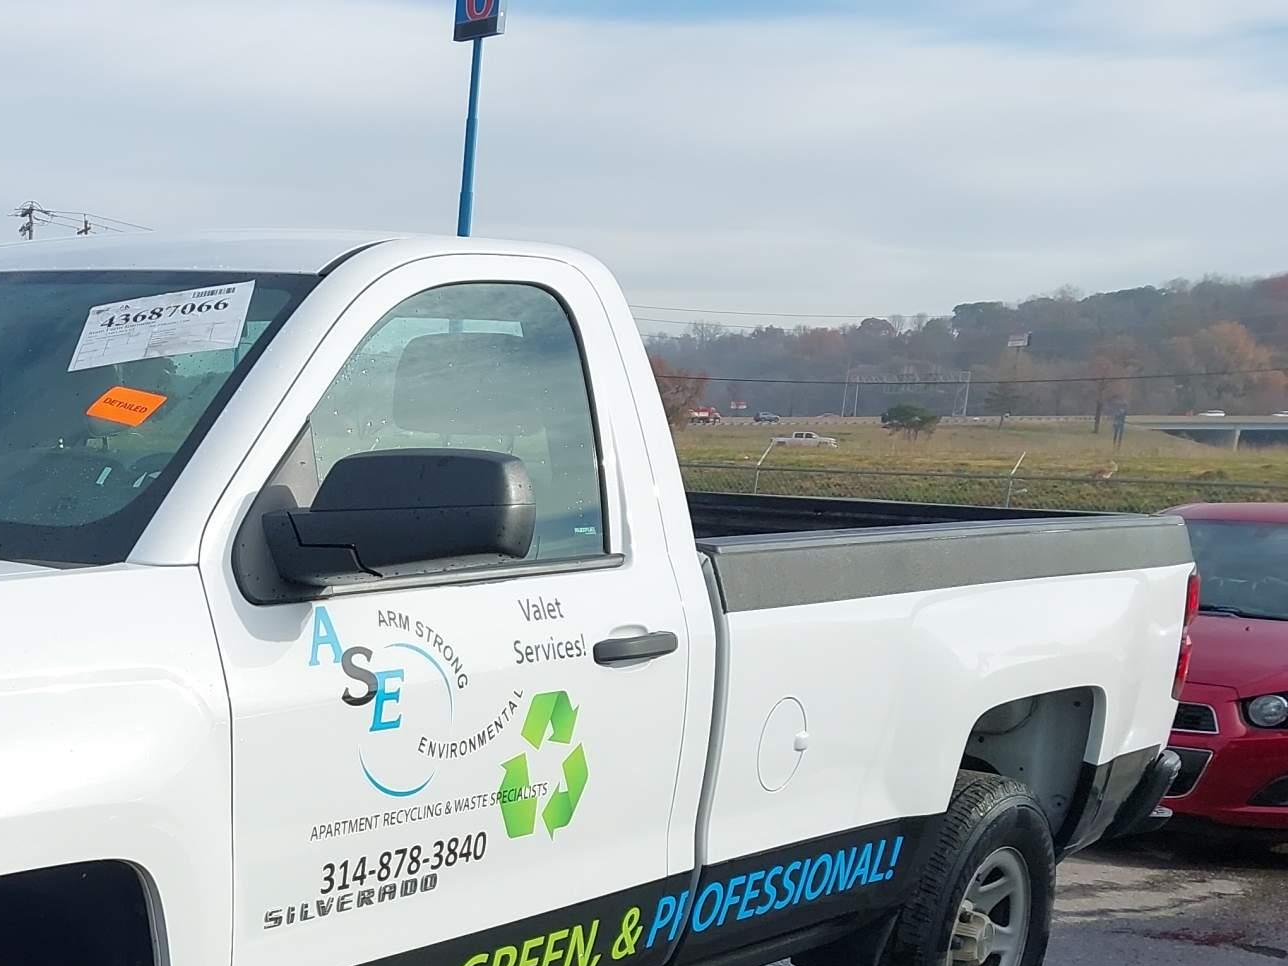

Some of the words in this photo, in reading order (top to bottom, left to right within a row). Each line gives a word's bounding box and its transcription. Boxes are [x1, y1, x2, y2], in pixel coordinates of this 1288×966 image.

[100, 298, 230, 328] 43687066
[103, 397, 148, 414] DETAILED
[517, 596, 564, 621] Valet
[378, 610, 410, 632] ARM
[415, 621, 468, 689] STRONG
[513, 633, 586, 664] Services!
[418, 688, 524, 759] ENVIRONMENTAL
[310, 814, 380, 841] APARTMENT
[383, 802, 442, 826] RECYCLING
[444, 800, 452, 815] &
[454, 794, 489, 812] WASTE
[490, 782, 548, 806] SPECIALISTS
[320, 831, 487, 895] 314-878-3840
[611, 907, 643, 960] &
